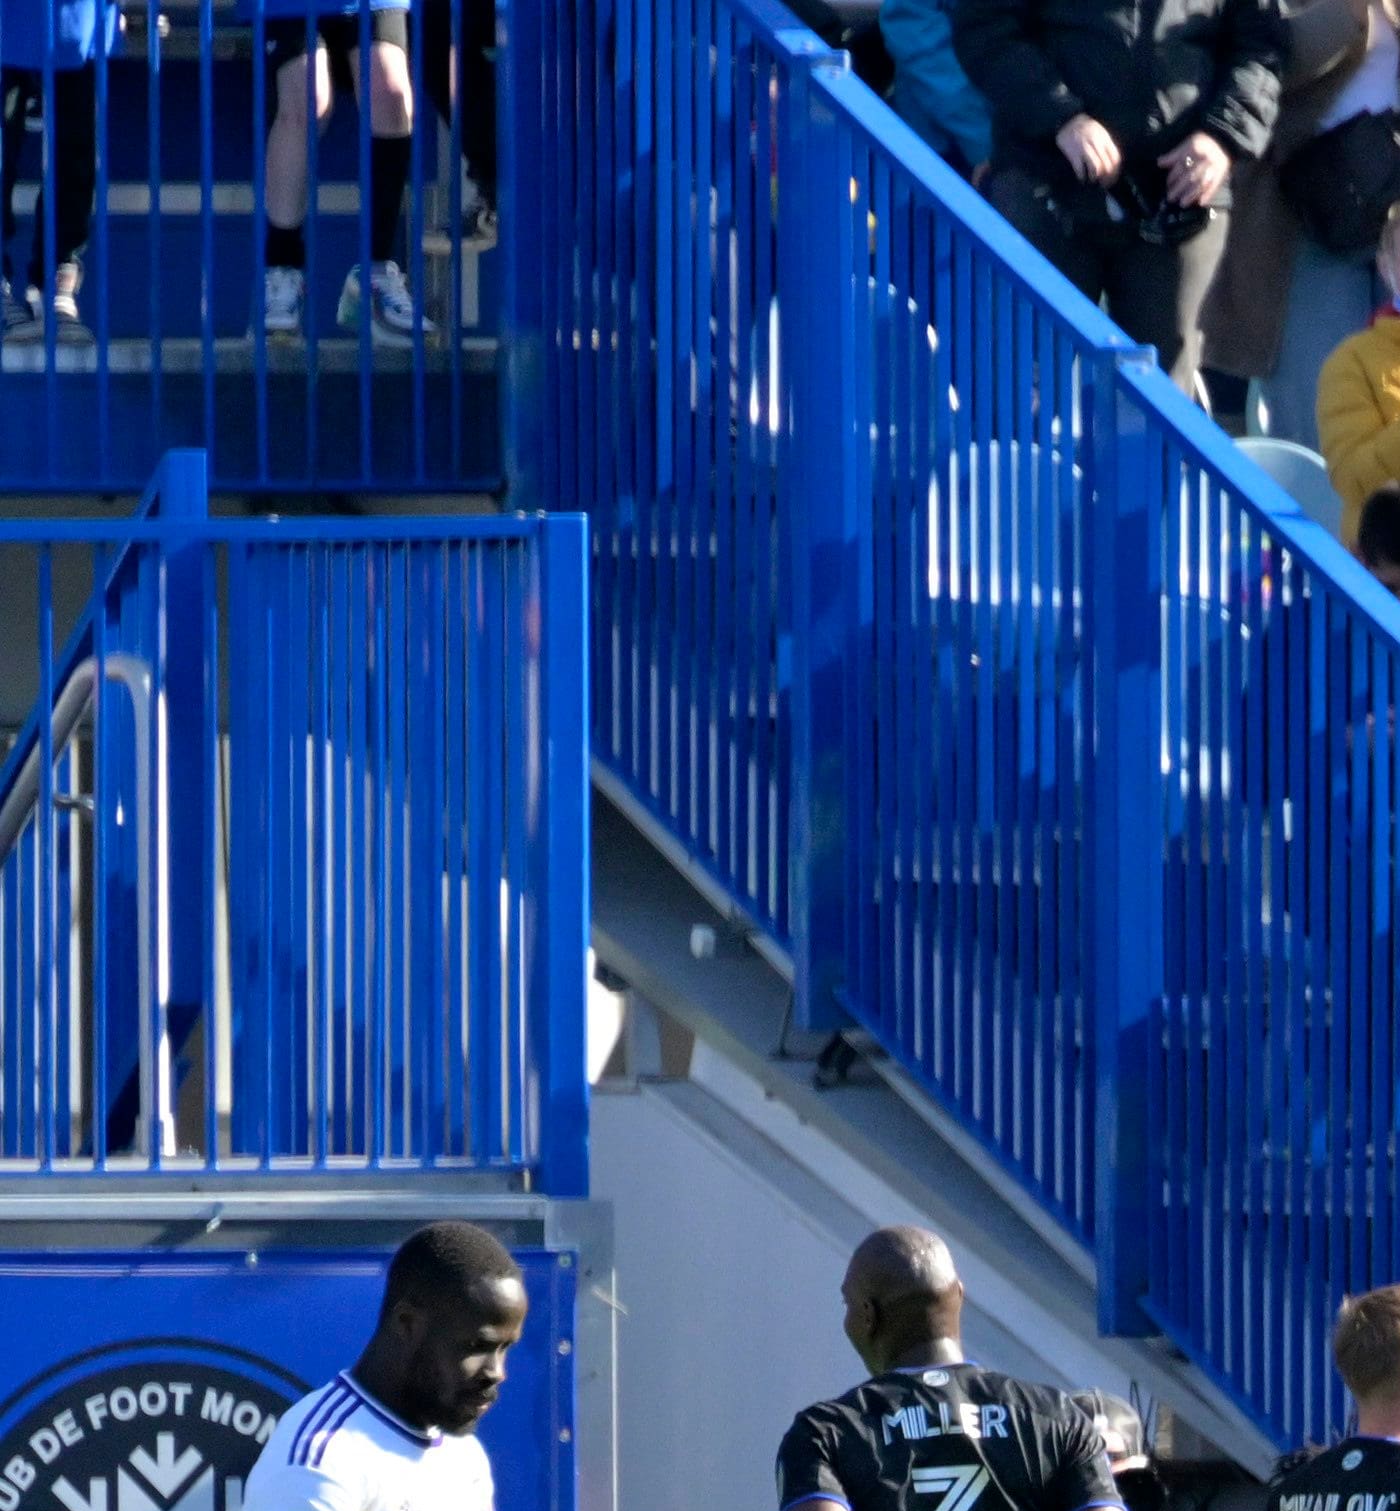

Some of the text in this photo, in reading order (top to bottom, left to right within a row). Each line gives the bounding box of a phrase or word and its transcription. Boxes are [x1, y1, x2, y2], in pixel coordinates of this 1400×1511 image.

[28, 1407, 85, 1466] DE
[83, 1381, 194, 1431] FOOT
[881, 1403, 1009, 1447] MILLER
